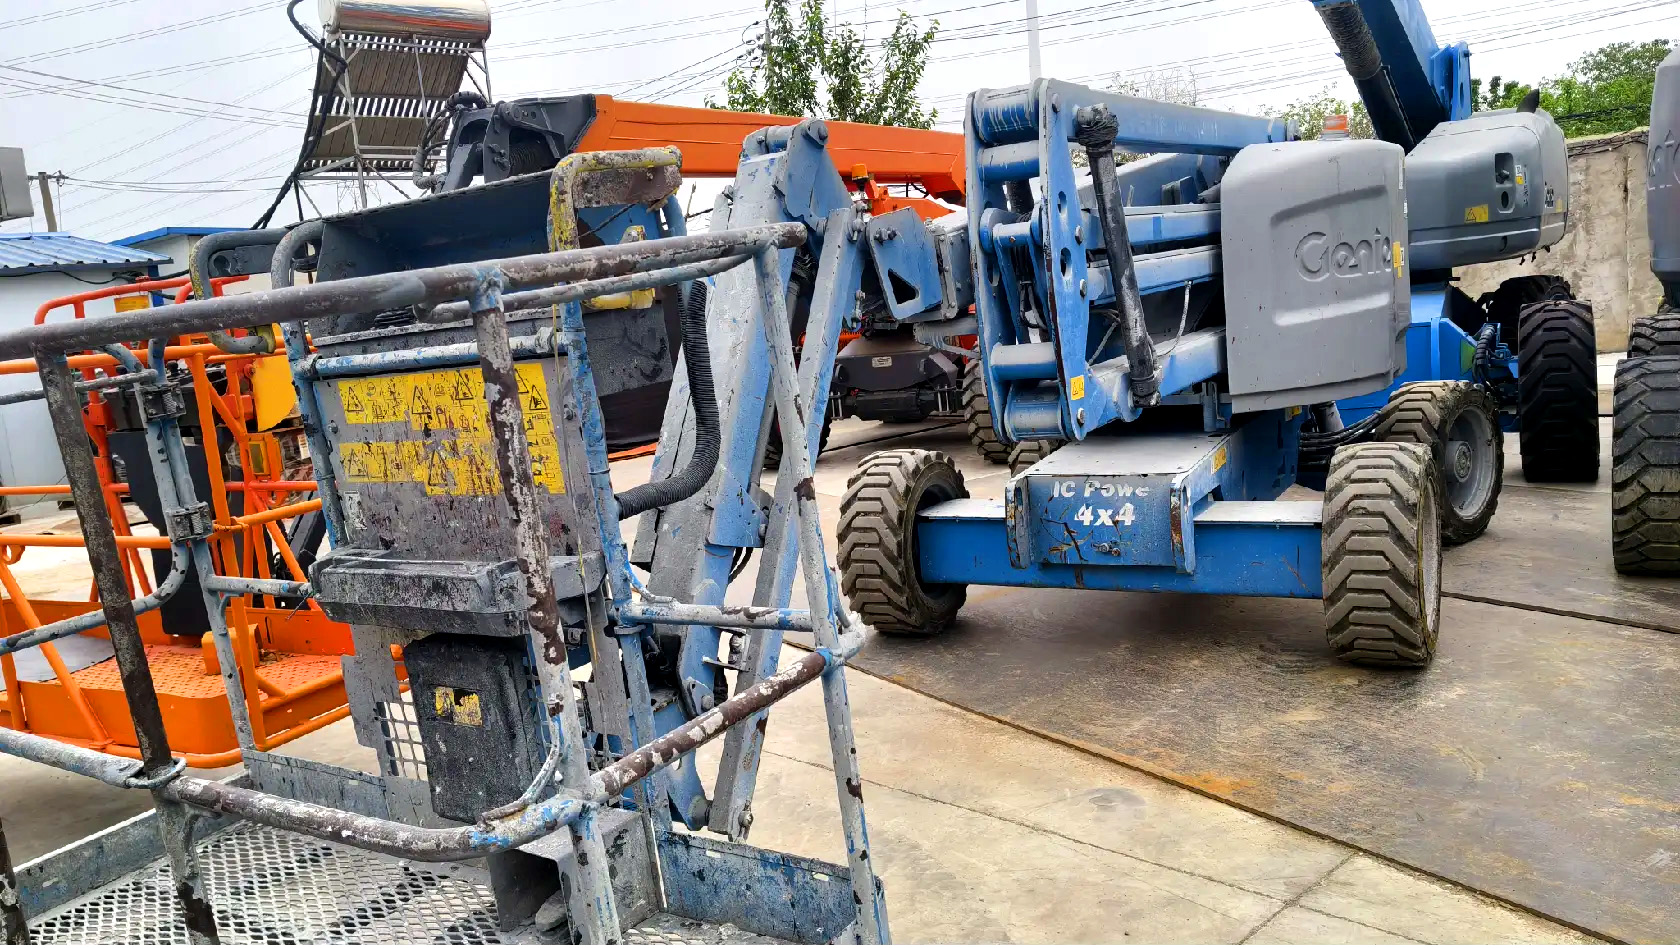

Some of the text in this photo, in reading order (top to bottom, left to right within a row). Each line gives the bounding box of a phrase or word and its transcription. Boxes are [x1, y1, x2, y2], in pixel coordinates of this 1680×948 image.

[1295, 227, 1391, 282] Genie
[1053, 480, 1076, 498] IC
[1074, 502, 1136, 526] 4x4
